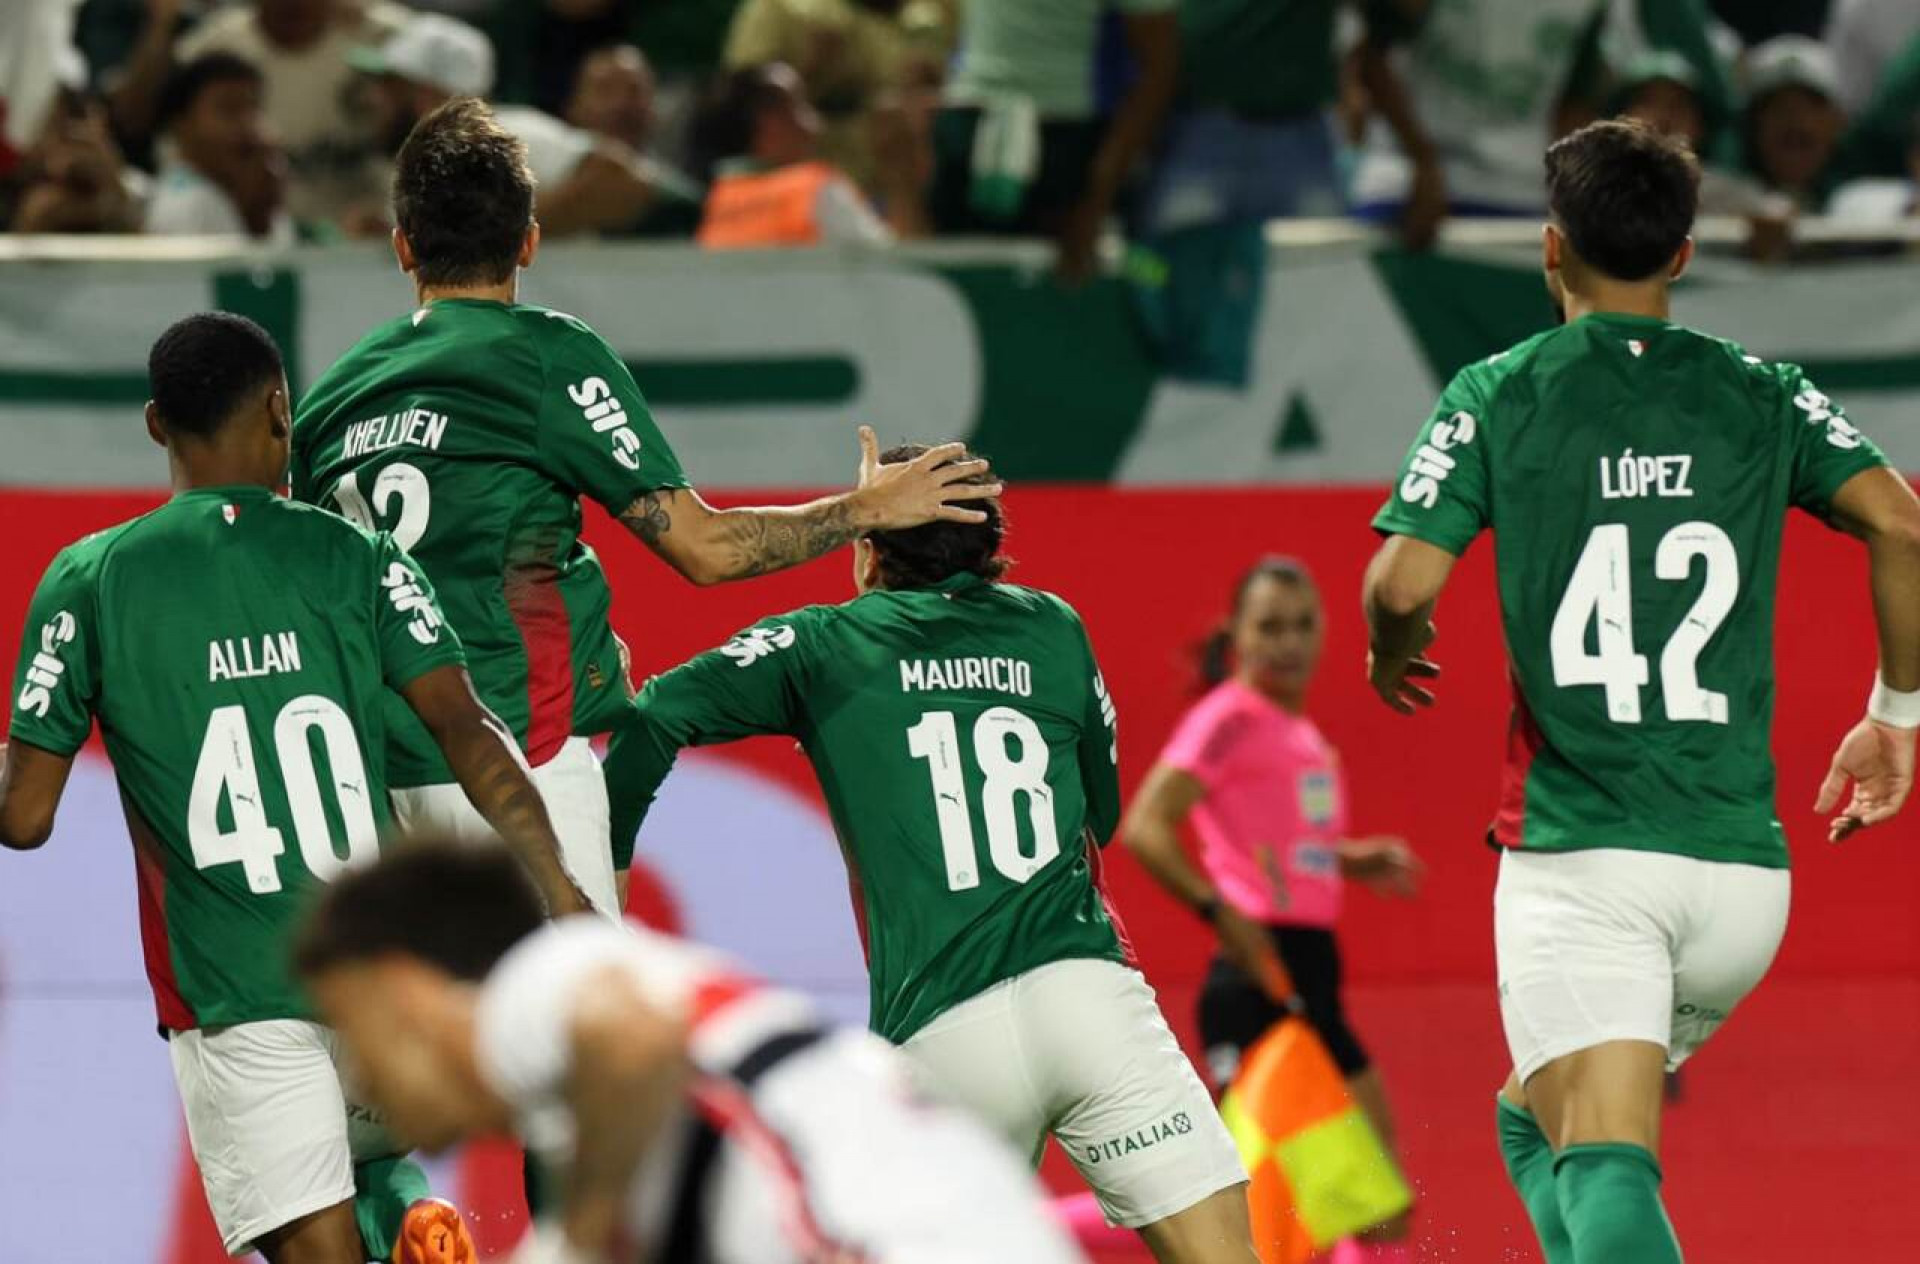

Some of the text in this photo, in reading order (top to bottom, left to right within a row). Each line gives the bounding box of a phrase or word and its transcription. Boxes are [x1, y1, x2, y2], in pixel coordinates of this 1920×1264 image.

[341, 408, 449, 460] KHELLVEN
[1600, 447, 1694, 499] LÓPEZ
[1549, 520, 1740, 725] 42
[208, 630, 302, 683] ALLAN
[899, 656, 1033, 697] MAURICIO
[186, 693, 383, 895] 40
[906, 705, 1062, 892] 18
[1085, 1121, 1175, 1163] D'ITALIA
